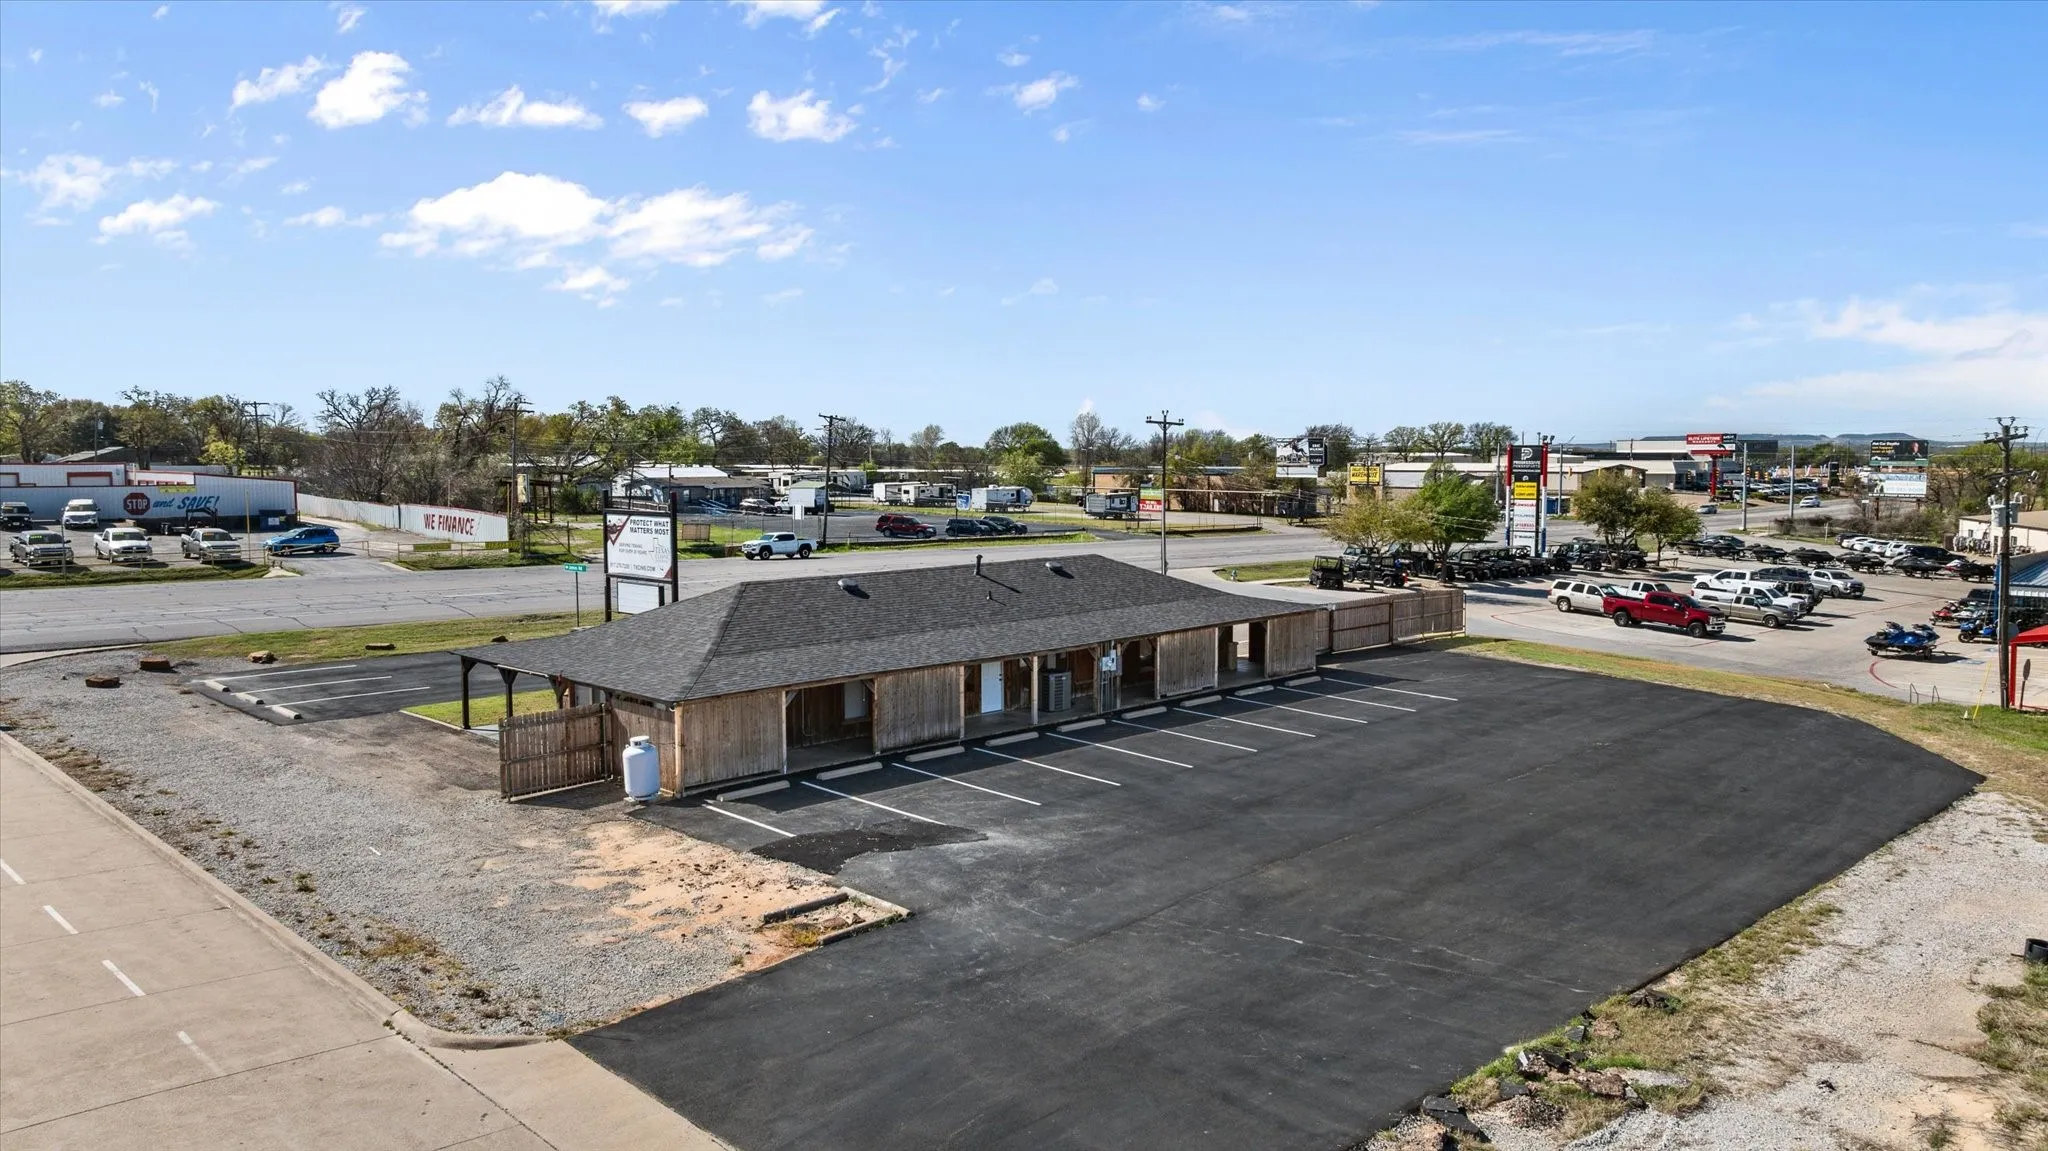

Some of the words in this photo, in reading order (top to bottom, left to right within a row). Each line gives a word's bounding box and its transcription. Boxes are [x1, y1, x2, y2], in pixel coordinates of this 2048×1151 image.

[126, 499, 148, 510] STOP
[152, 498, 175, 508] and
[177, 496, 220, 509] SAVE!
[424, 513, 435, 530] WE
[438, 514, 475, 535] FINANCE
